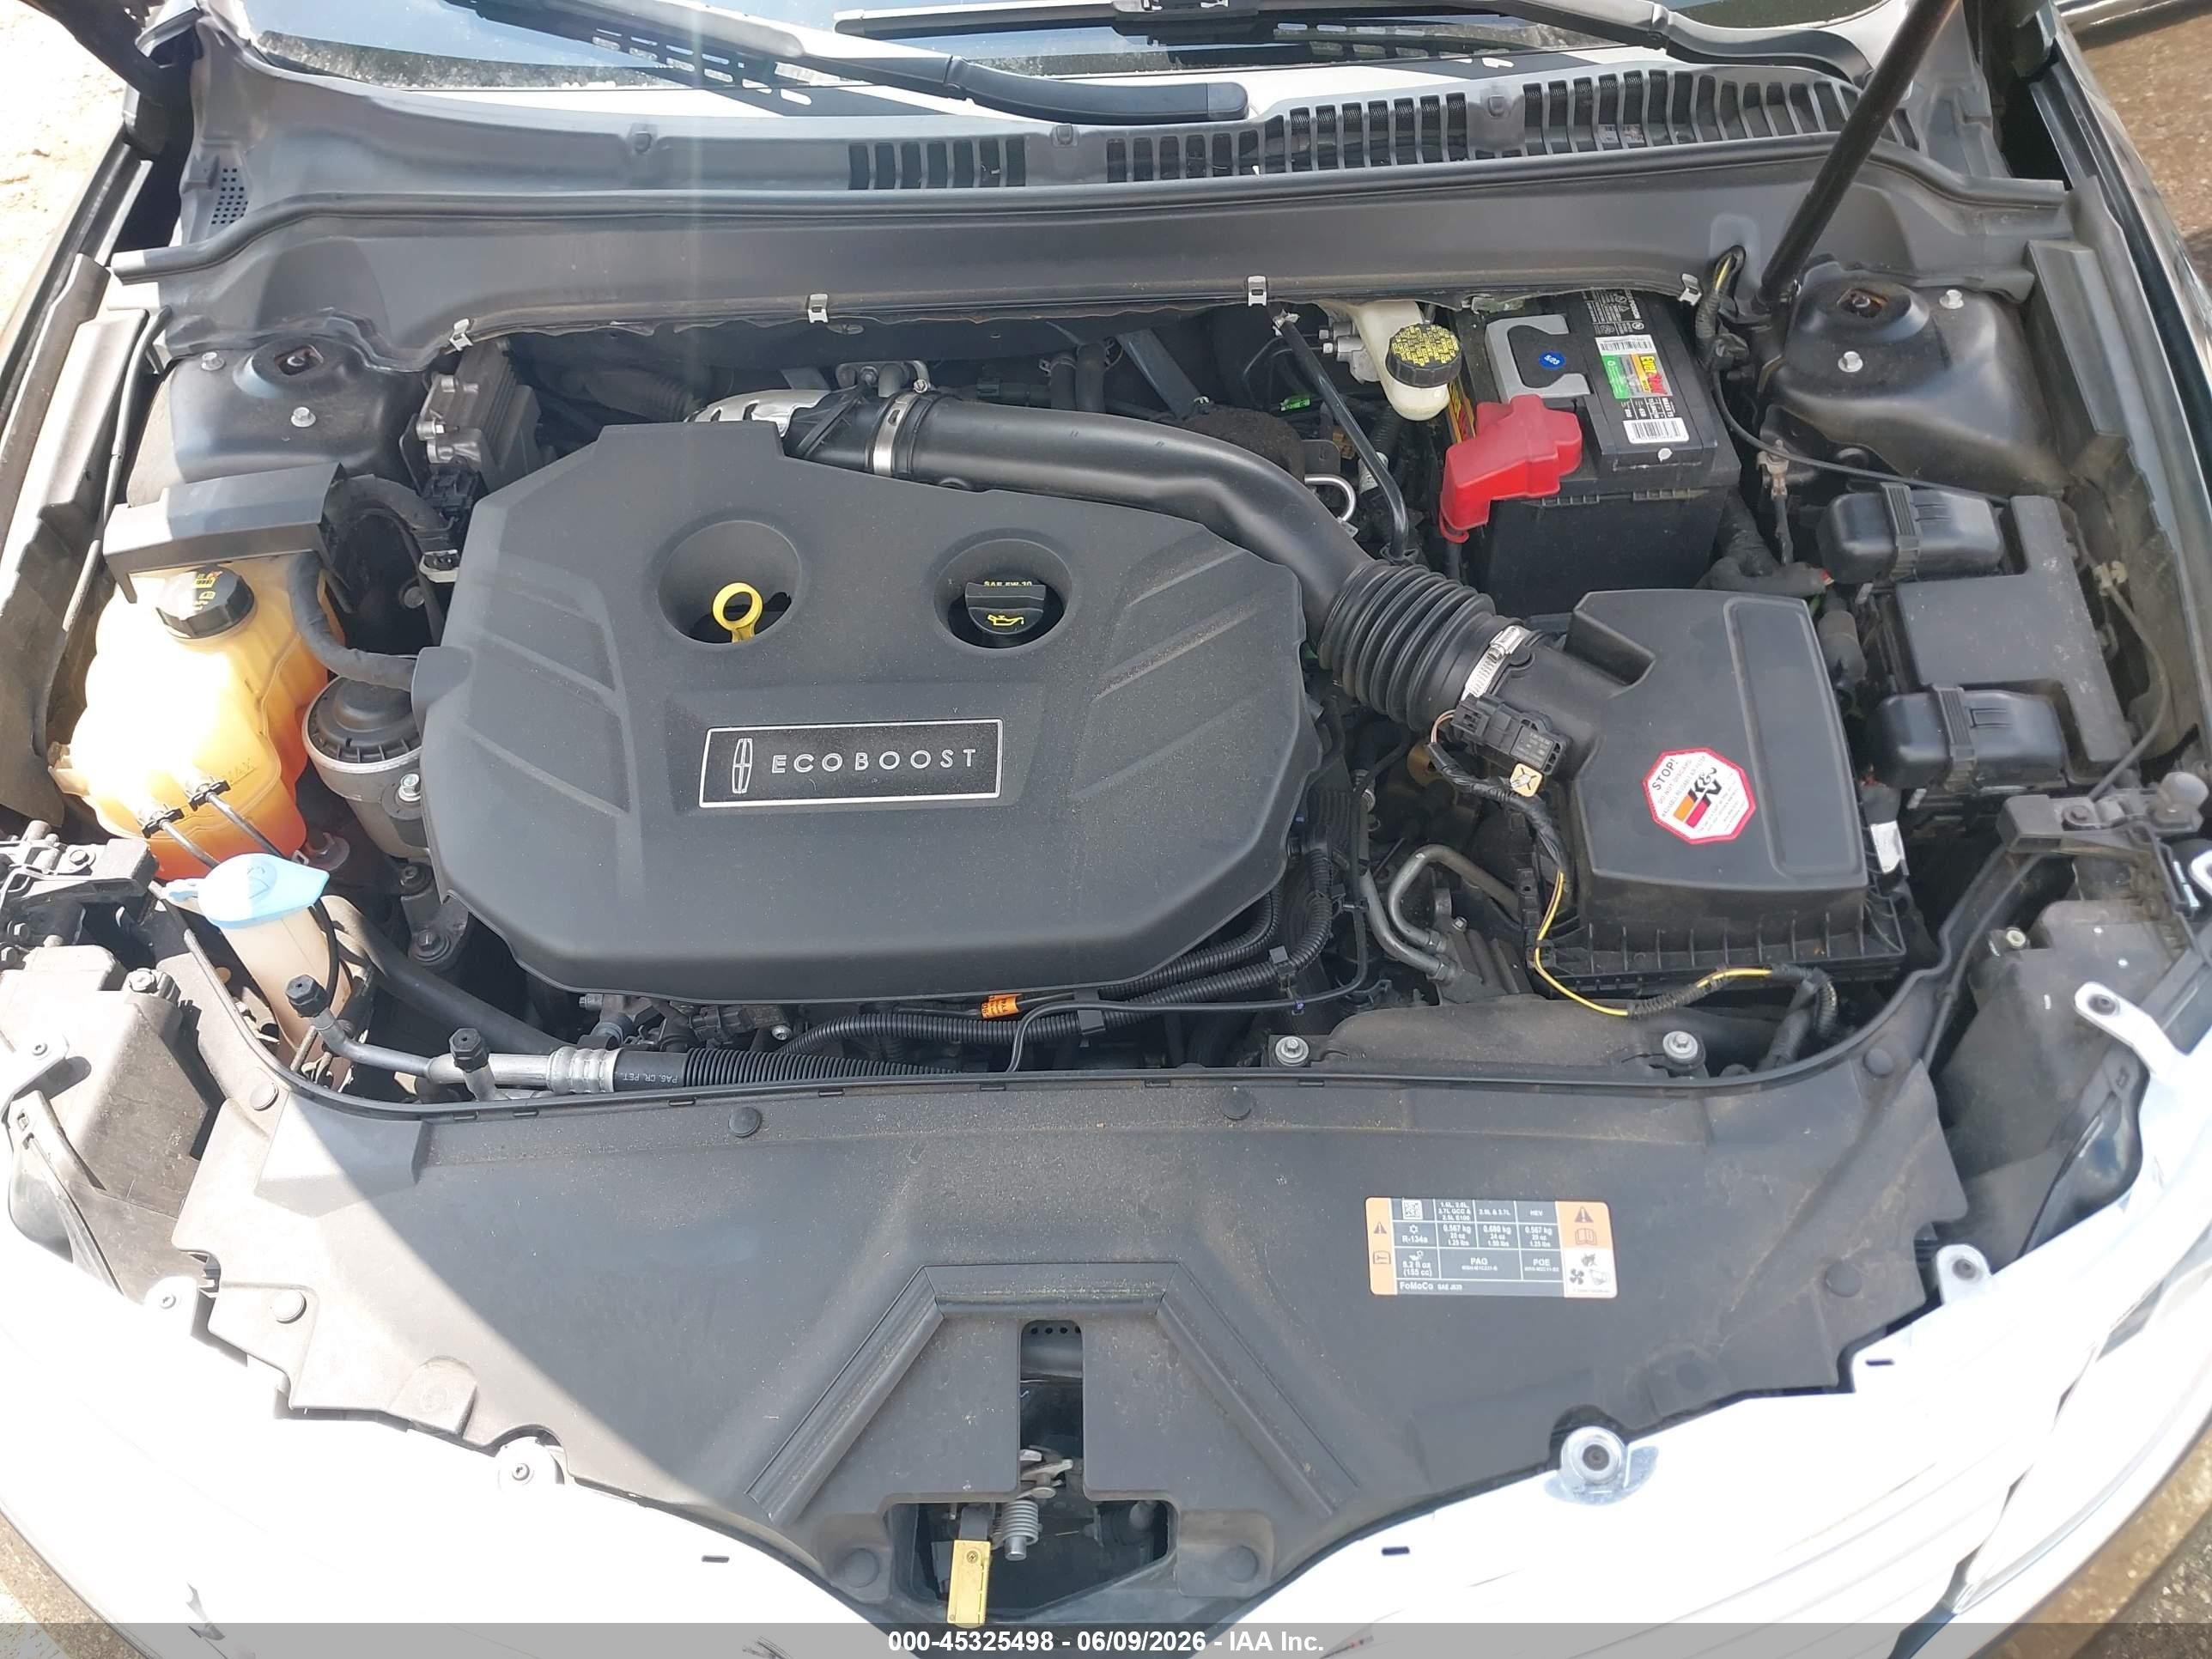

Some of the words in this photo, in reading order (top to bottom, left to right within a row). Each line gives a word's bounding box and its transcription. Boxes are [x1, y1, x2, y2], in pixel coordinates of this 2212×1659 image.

[771, 749, 976, 774] ECOBOOST
[1651, 758, 1679, 791] STOP!
[1462, 1224, 1472, 1234] kg
[1502, 1225, 1512, 1235] kg
[1543, 1226, 1553, 1236] kg
[1401, 1235, 1428, 1244] R-134a
[1470, 1257, 1488, 1266] PAG
[1400, 1282, 1434, 1291] FoMoCo
